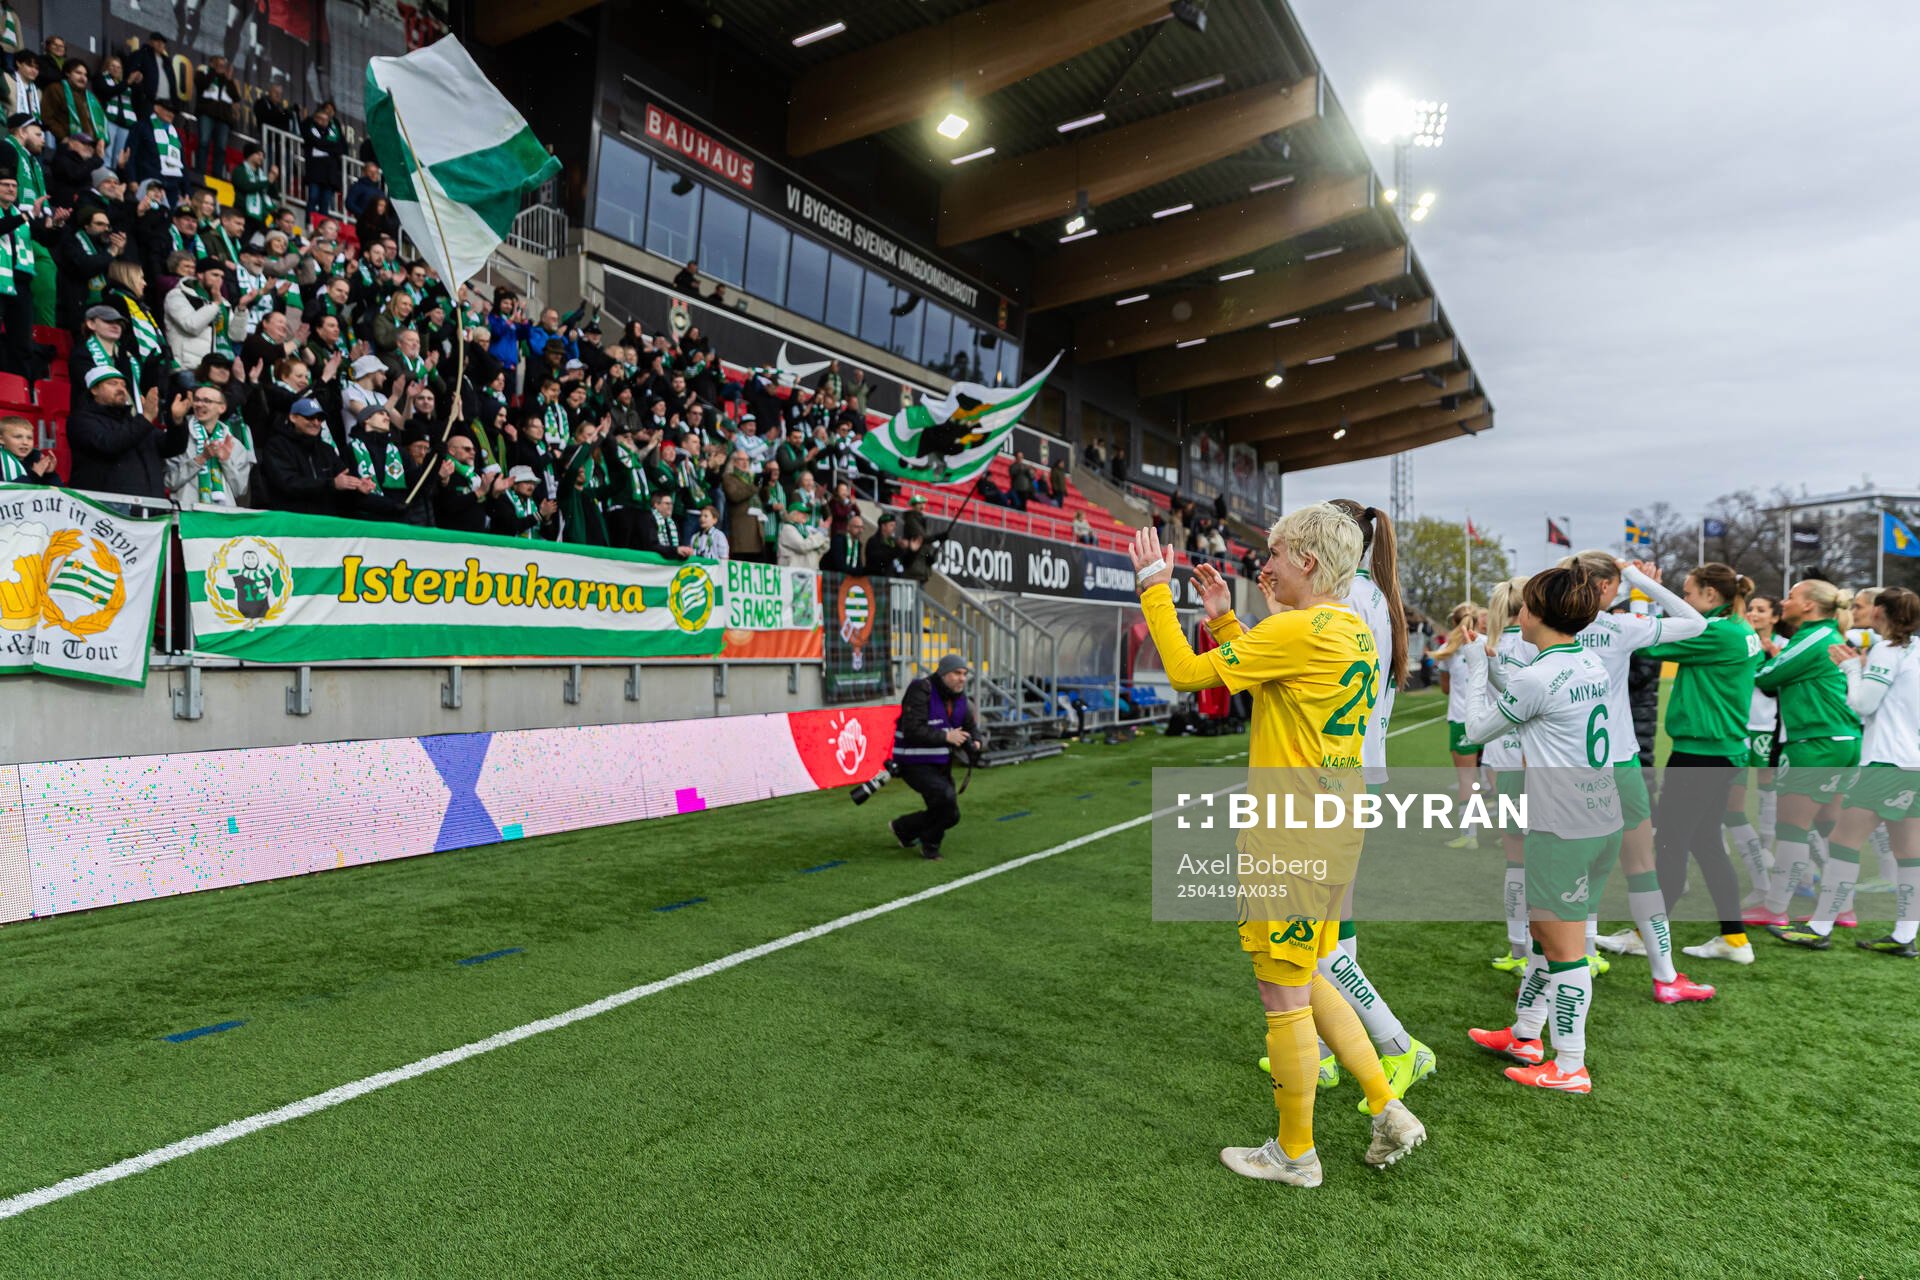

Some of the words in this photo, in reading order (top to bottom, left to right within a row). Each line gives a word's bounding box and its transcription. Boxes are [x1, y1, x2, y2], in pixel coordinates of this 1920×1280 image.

[648, 109, 754, 189] BAUHAUS
[786, 184, 801, 212] VI
[803, 193, 852, 241] BYGGER
[853, 223, 898, 268] SVENSK
[69, 502, 87, 526] in
[91, 518, 140, 565] Style
[338, 555, 647, 613] Isterbukarna
[728, 561, 782, 597] BAJEN
[1028, 547, 1070, 590] NÖJD
[730, 599, 784, 628] SAMBA
[62, 638, 119, 661] Tour
[1586, 703, 1610, 770] 6
